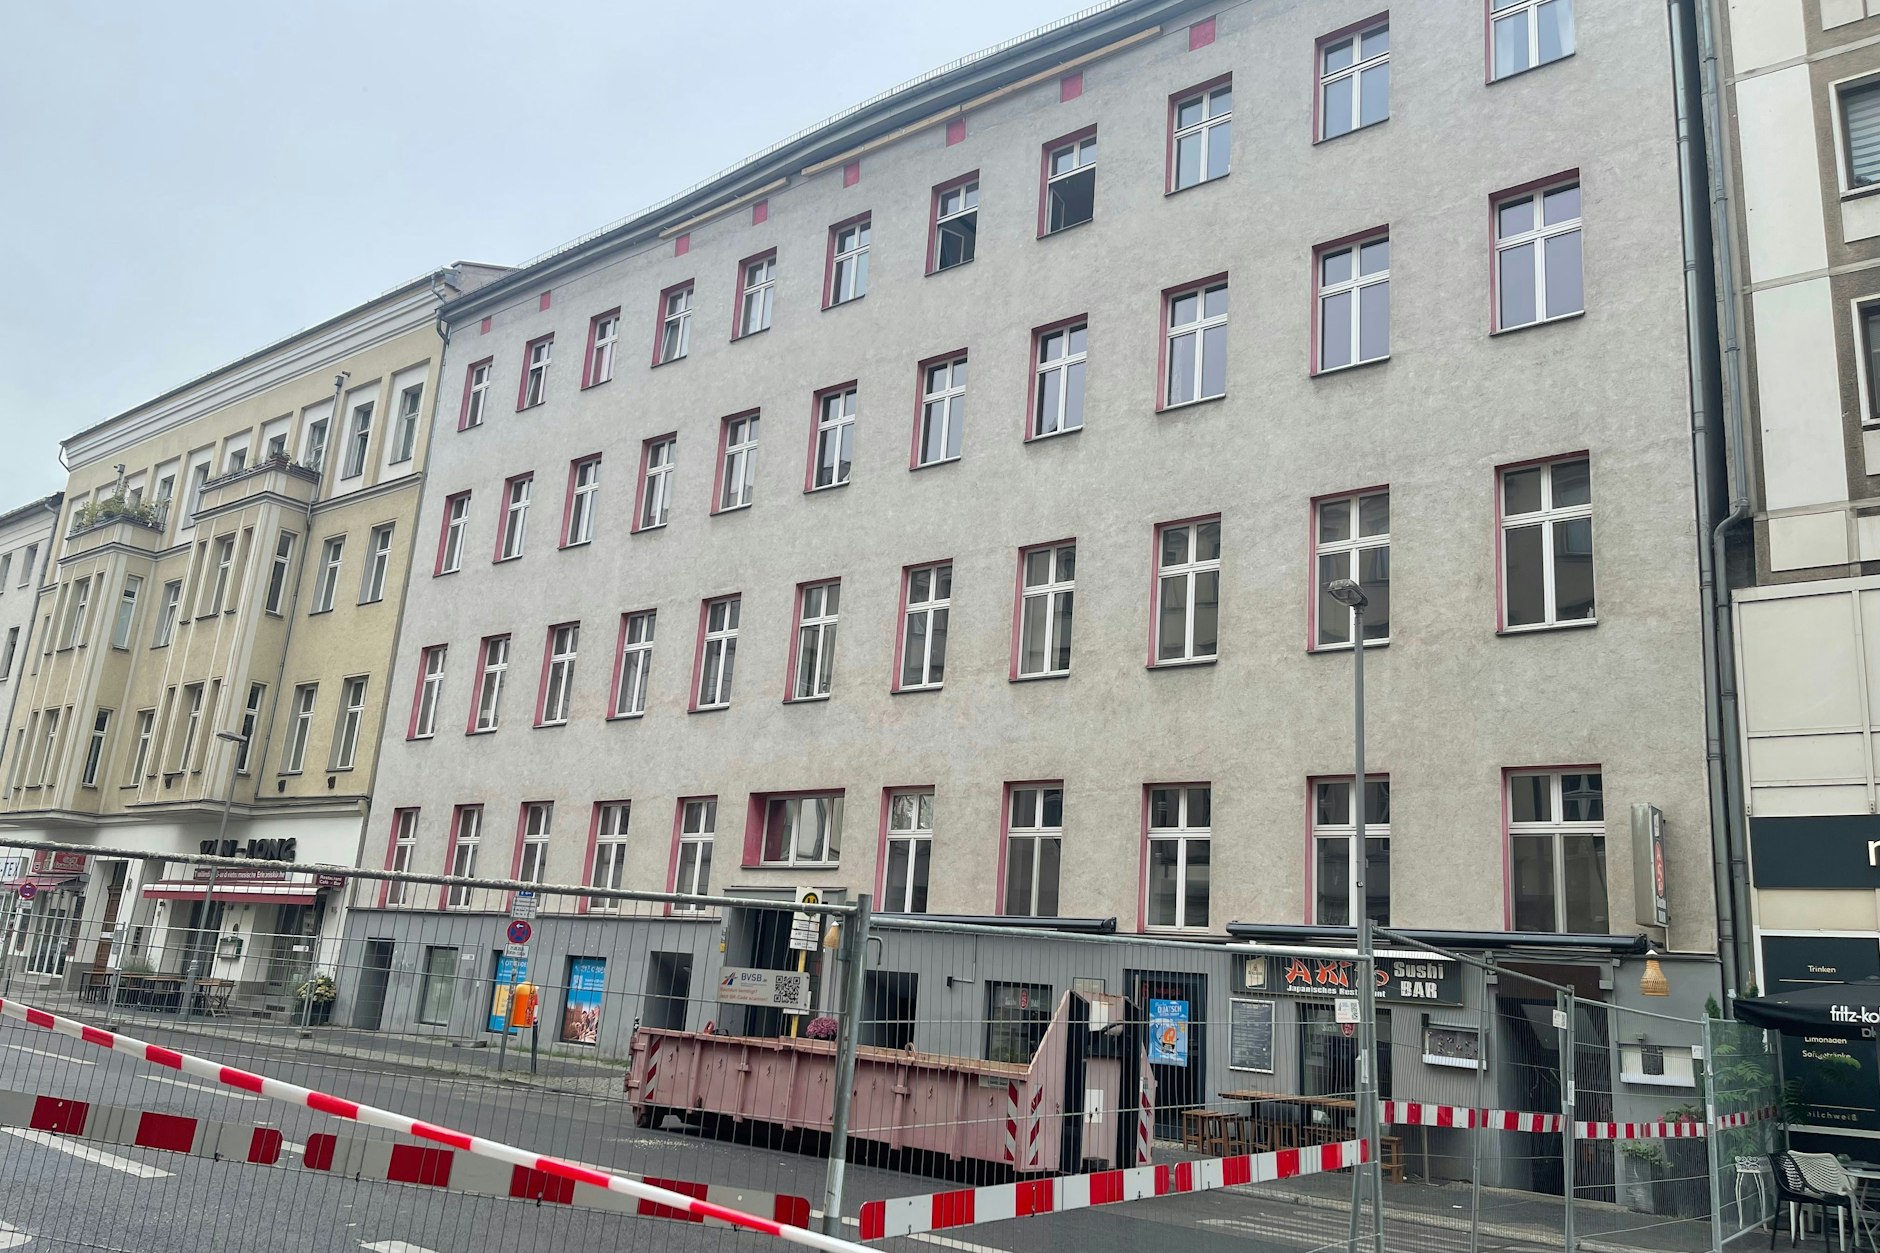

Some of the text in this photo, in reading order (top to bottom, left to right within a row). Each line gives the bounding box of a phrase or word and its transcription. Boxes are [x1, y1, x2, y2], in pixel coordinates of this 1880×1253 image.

[1393, 961, 1444, 980] Sushi
[1807, 965, 1837, 973] Trinken
[1286, 984, 1386, 998] Japanisches Restnt
[1400, 980, 1438, 999] BAR
